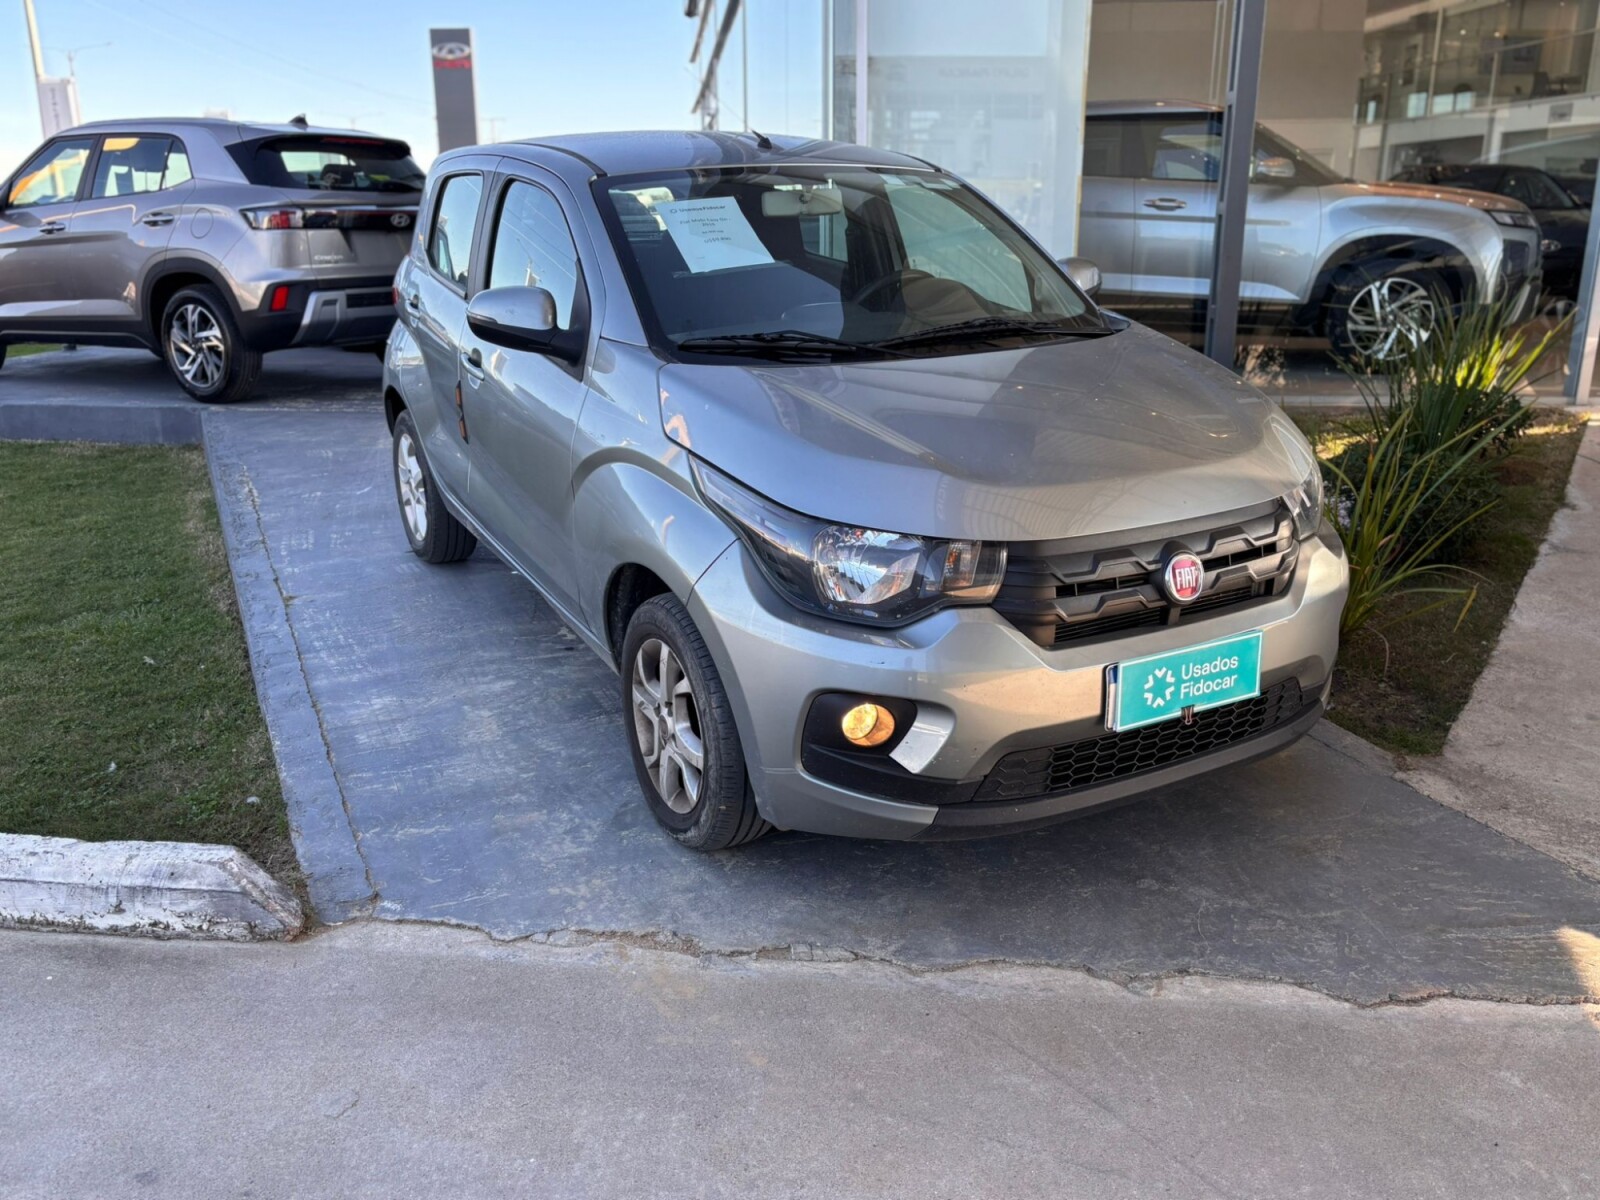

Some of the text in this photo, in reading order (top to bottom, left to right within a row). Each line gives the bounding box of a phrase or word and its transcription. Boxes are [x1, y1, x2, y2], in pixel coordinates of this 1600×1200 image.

[1175, 566, 1197, 590] FIAT
[1181, 655, 1239, 680] Usados
[1180, 674, 1238, 699] Fidocar
